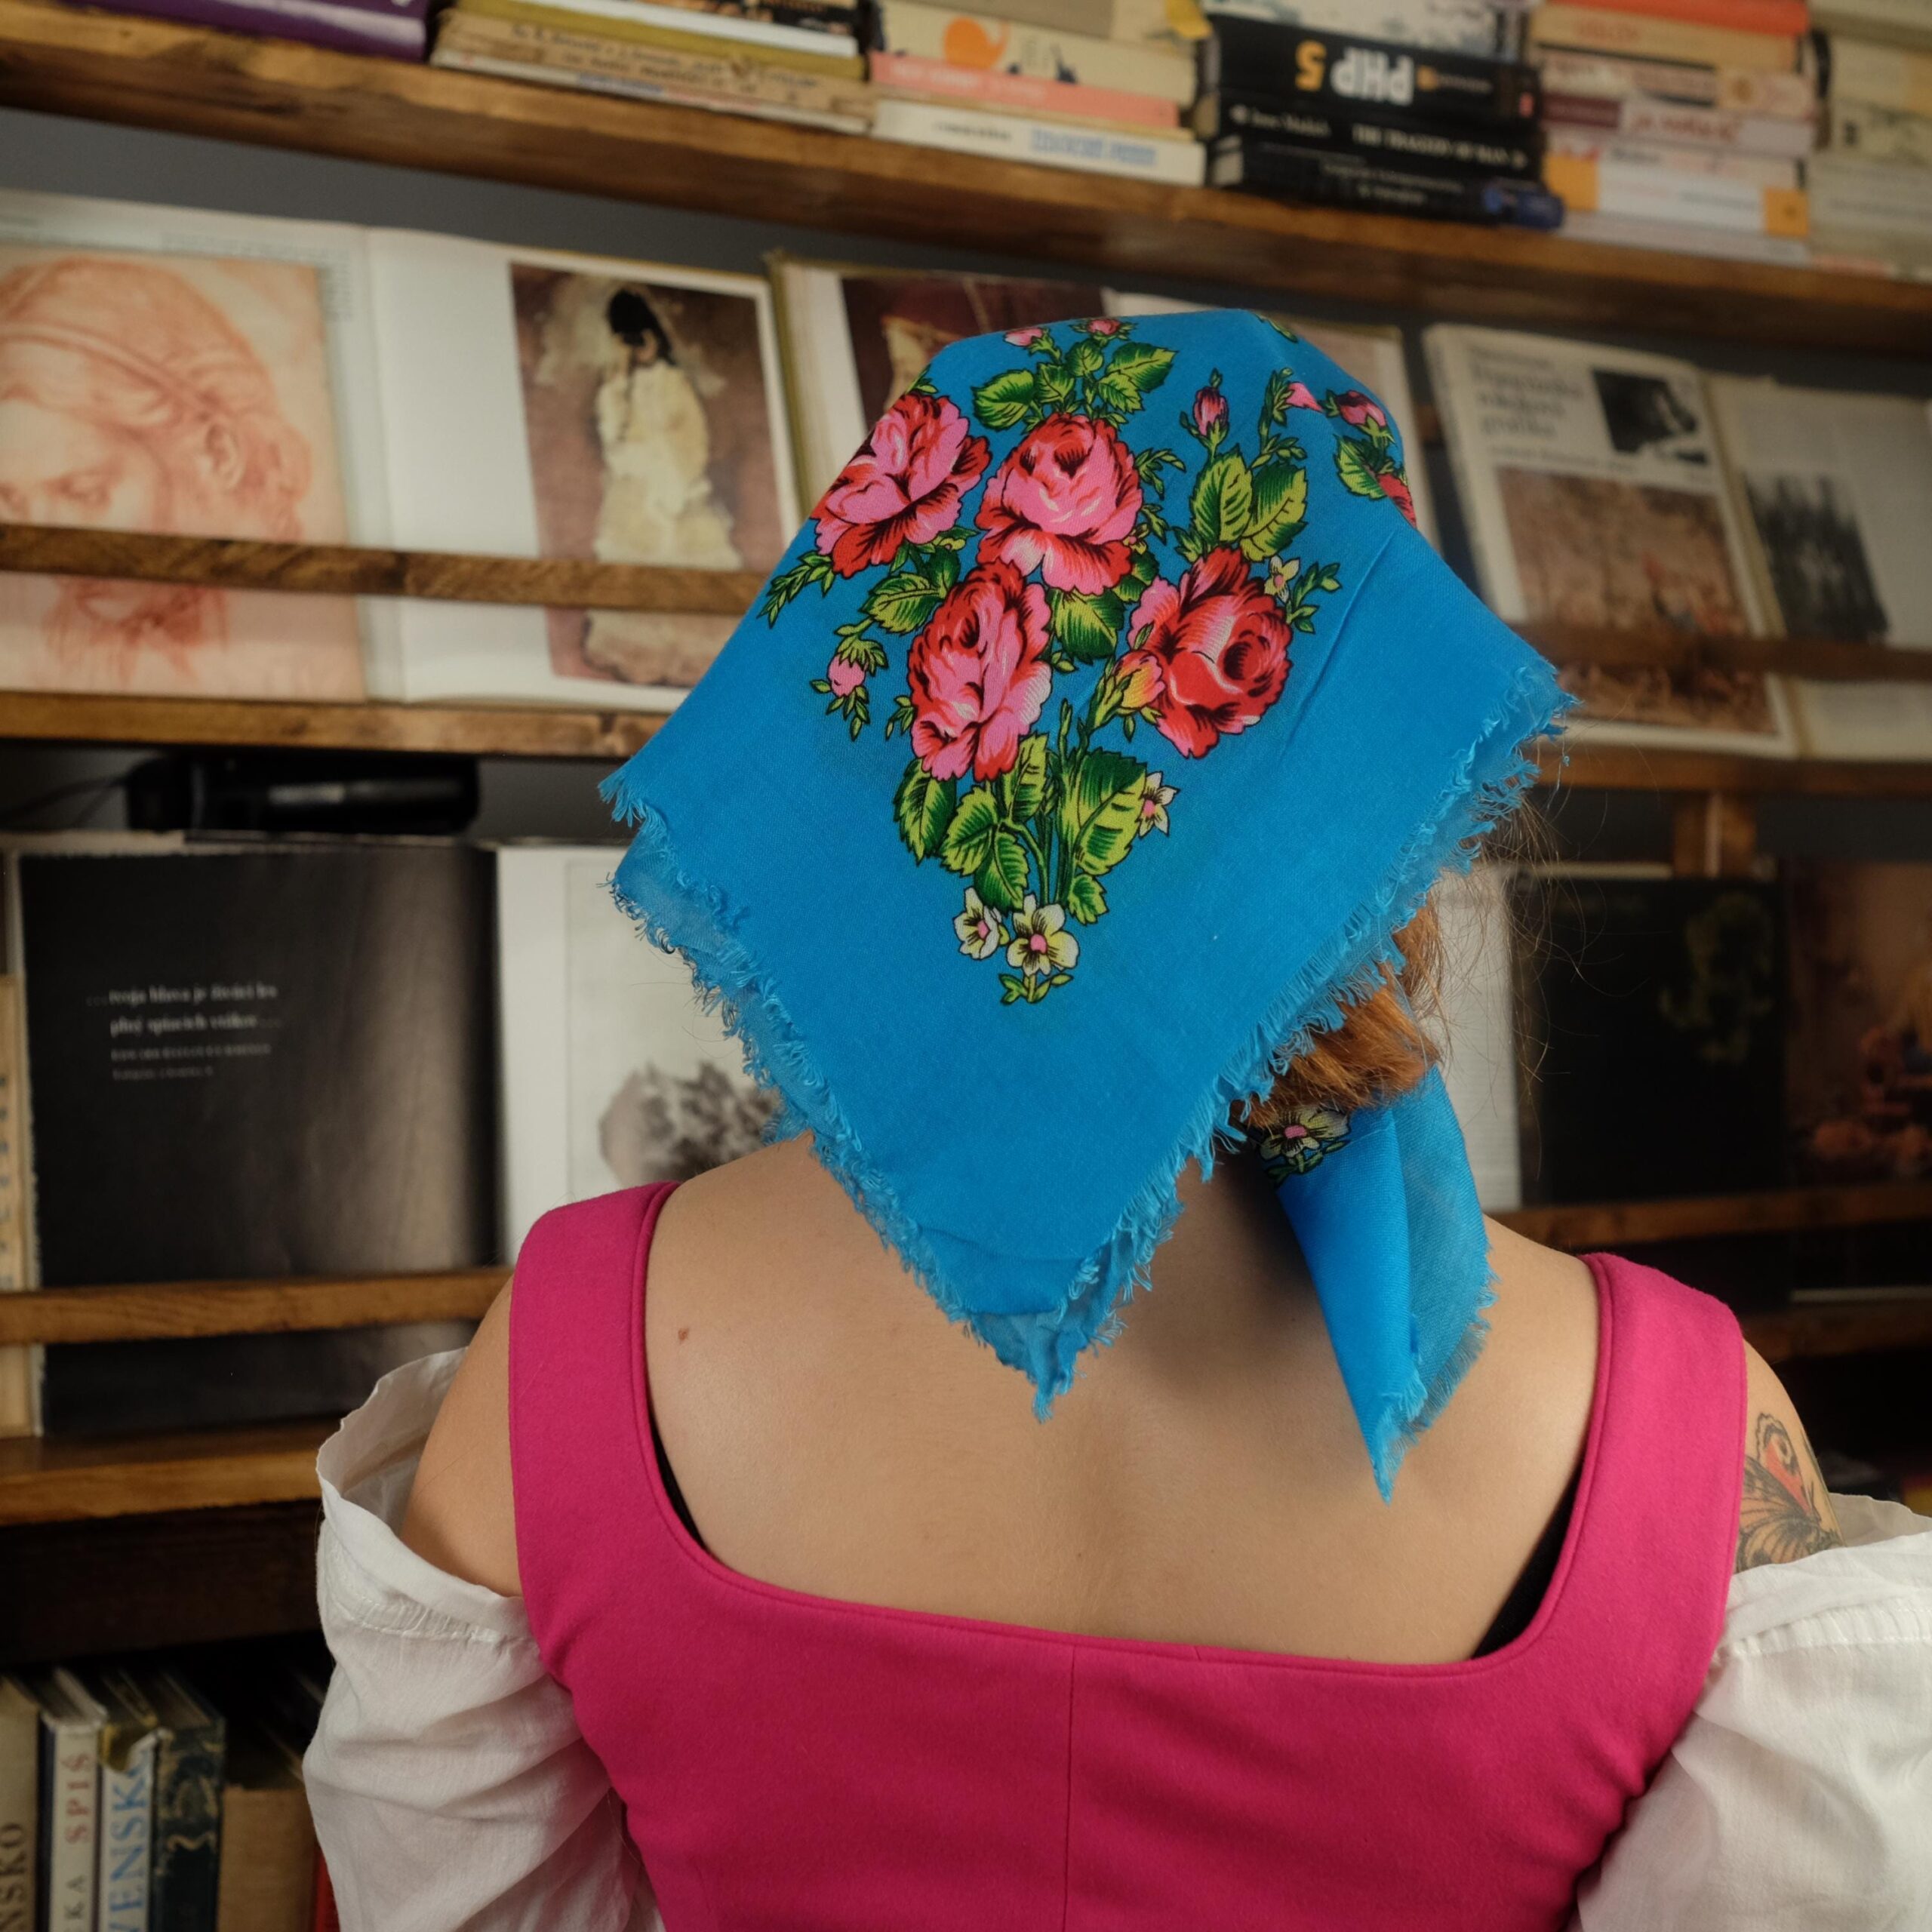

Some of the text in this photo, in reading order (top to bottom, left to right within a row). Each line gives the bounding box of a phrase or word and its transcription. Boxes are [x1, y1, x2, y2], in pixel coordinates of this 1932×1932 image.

[1295, 40, 1414, 106] PHP 5
[63, 1875, 86, 1932] KA
